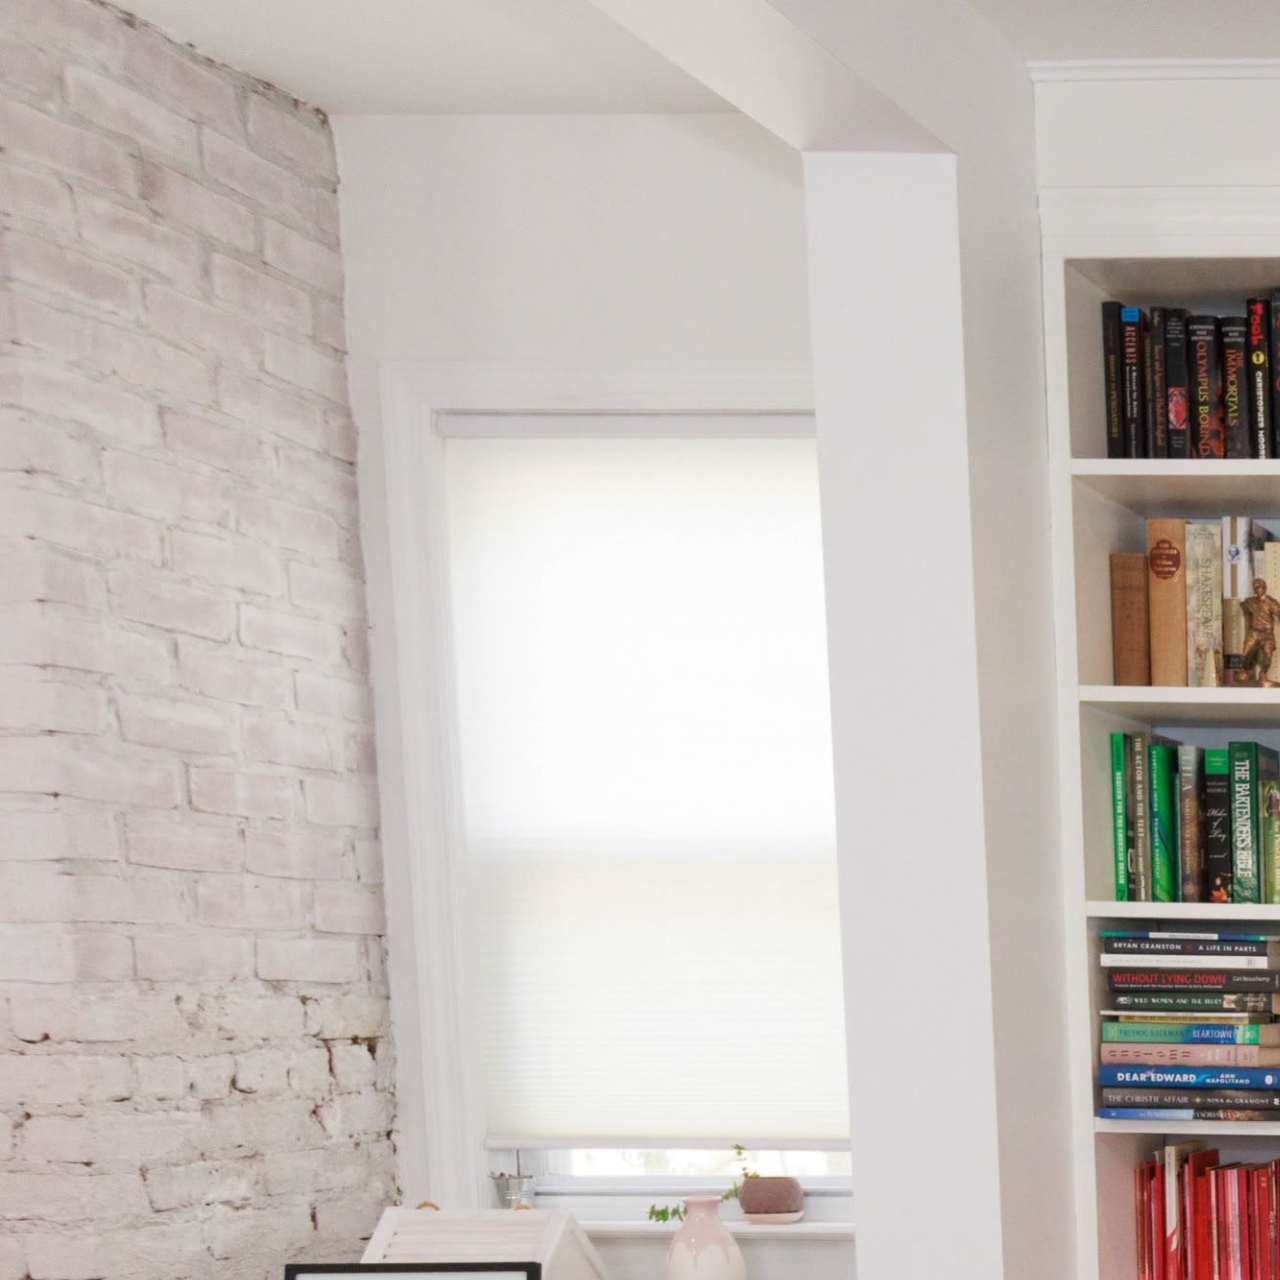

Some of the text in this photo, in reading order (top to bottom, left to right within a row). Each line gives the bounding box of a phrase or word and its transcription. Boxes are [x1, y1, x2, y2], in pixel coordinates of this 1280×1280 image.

[1197, 342, 1212, 456] OLYMPUS BOUND
[1227, 350, 1239, 427] IMMORTALS
[1200, 558, 1214, 640] SHAKESPEARE
[1135, 755, 1144, 780] ACTOR
[1181, 755, 1194, 792] LILA
[1234, 760, 1250, 782] THE
[1140, 943, 1182, 951] CRANSTON
[1234, 945, 1257, 953] PARTS
[1112, 974, 1227, 985] WITHOUT DOWN
[1193, 1031, 1234, 1040] BEARTOWN
[1116, 1072, 1197, 1083] DEAR EDWARD
